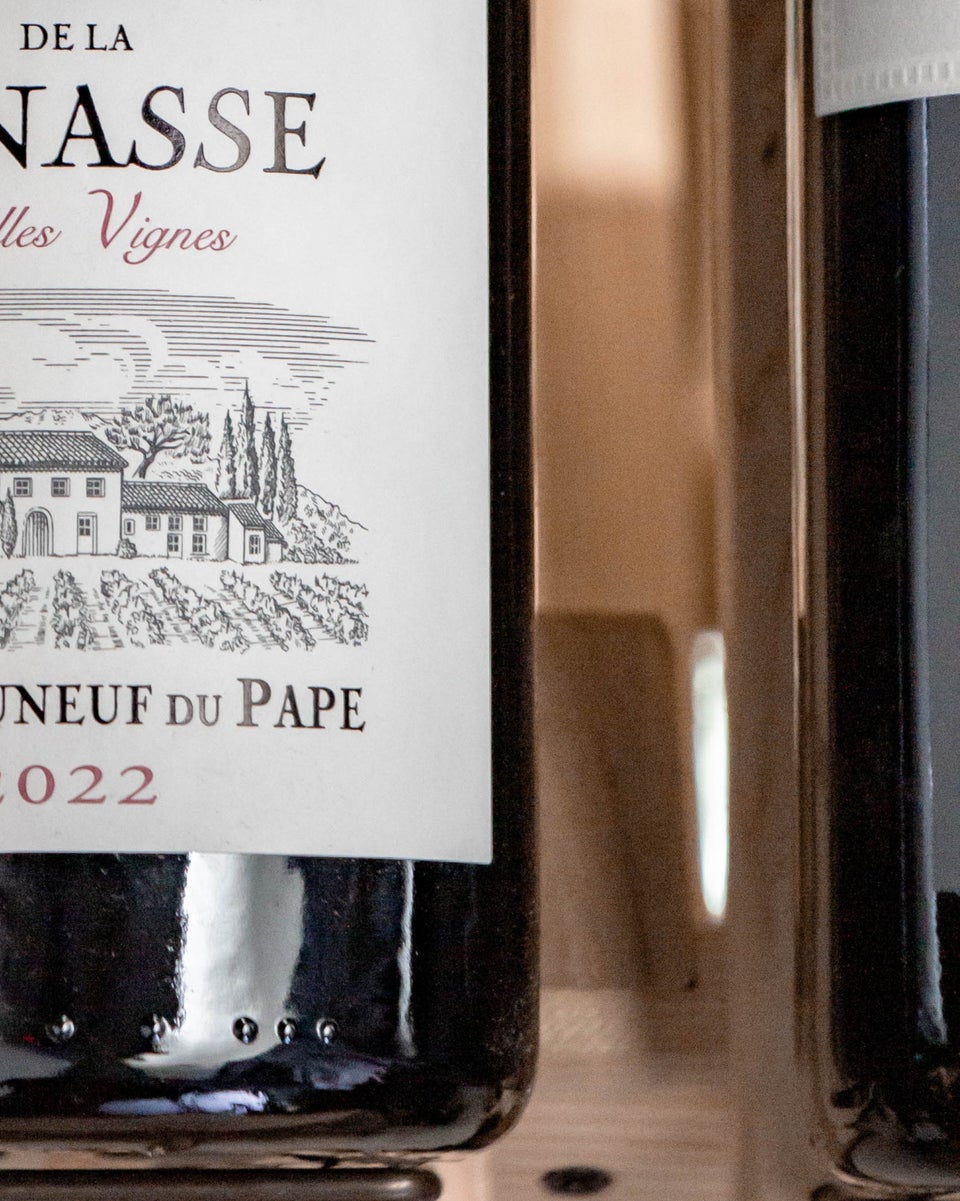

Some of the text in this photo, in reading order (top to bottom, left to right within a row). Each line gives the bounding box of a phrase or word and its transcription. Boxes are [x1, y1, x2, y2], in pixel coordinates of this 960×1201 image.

[19, 22, 136, 52] DE LA
[87, 189, 238, 266] Vignes
[165, 693, 224, 728] DU
[236, 677, 367, 733] PAPE
